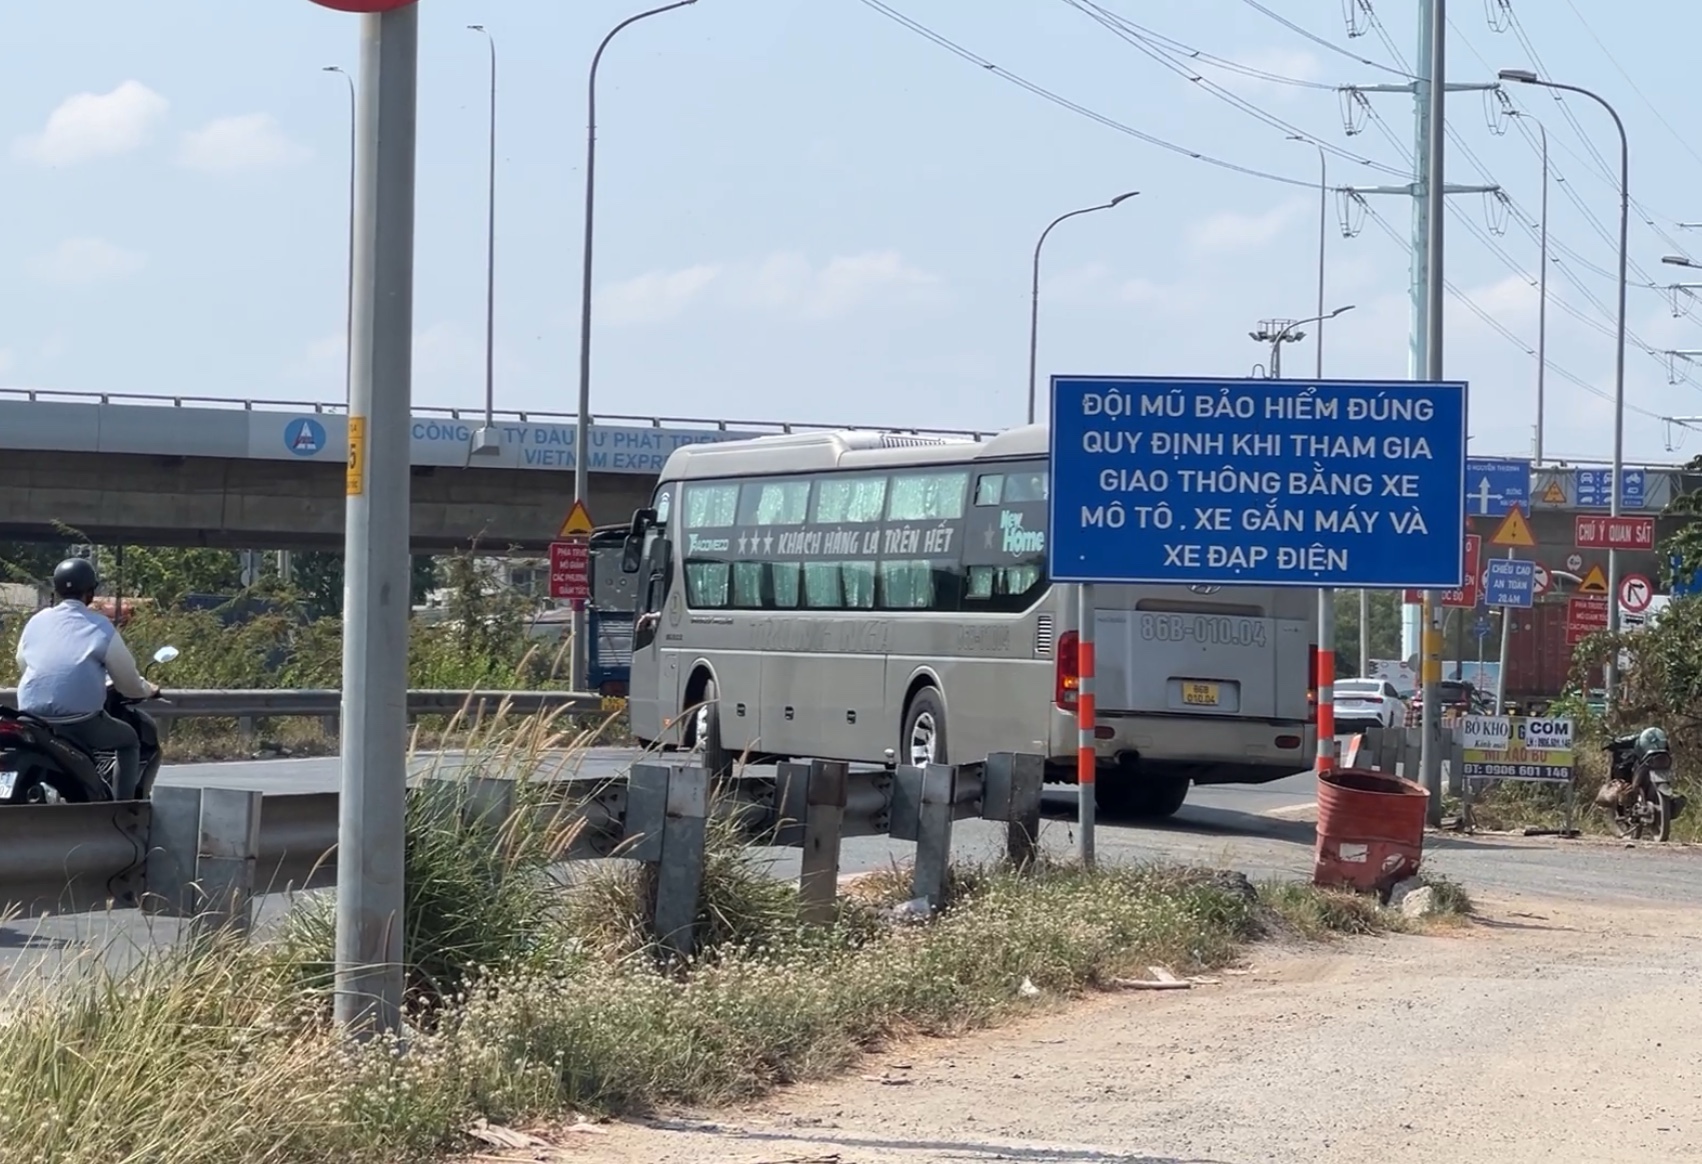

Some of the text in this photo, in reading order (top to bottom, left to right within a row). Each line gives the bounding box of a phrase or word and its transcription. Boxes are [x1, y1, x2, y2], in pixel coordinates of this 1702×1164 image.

[1082, 386, 1435, 422] ĐỘI MŨ BẢO HIỂM ĐÚNG
[412, 421, 470, 441] CÔNG
[503, 428, 528, 443] TY
[1082, 430, 1433, 461] QUY ĐỊNH KHI THAM GIA
[1100, 461, 1420, 498] GIAO THÔNG BẰNG XE
[1000, 510, 1023, 529] New
[1081, 500, 1125, 528] MÔ
[1194, 508, 1232, 531] XE
[1242, 498, 1304, 532] GẮN
[1315, 504, 1380, 534] MÁY
[1389, 505, 1429, 535] VÀ
[777, 525, 822, 555] KHÁCH
[823, 526, 860, 555] HÀNG
[884, 524, 920, 553] TRÊN
[923, 519, 955, 553] HẾT
[1002, 527, 1045, 554] Home
[1578, 520, 1652, 543] CHÚ Ý QUAN SÁT
[1163, 542, 1348, 577] XE ĐẠP ĐIỆN
[1515, 565, 1532, 576] CAO
[1493, 579, 1504, 589] AN
[1141, 613, 1267, 648] 86B-010.04
[1483, 721, 1509, 737] KHO
[1530, 719, 1569, 735] CƠM
[1485, 764, 1516, 775] 0906
[1519, 766, 1541, 776] 601
[1546, 767, 1569, 778] 146
